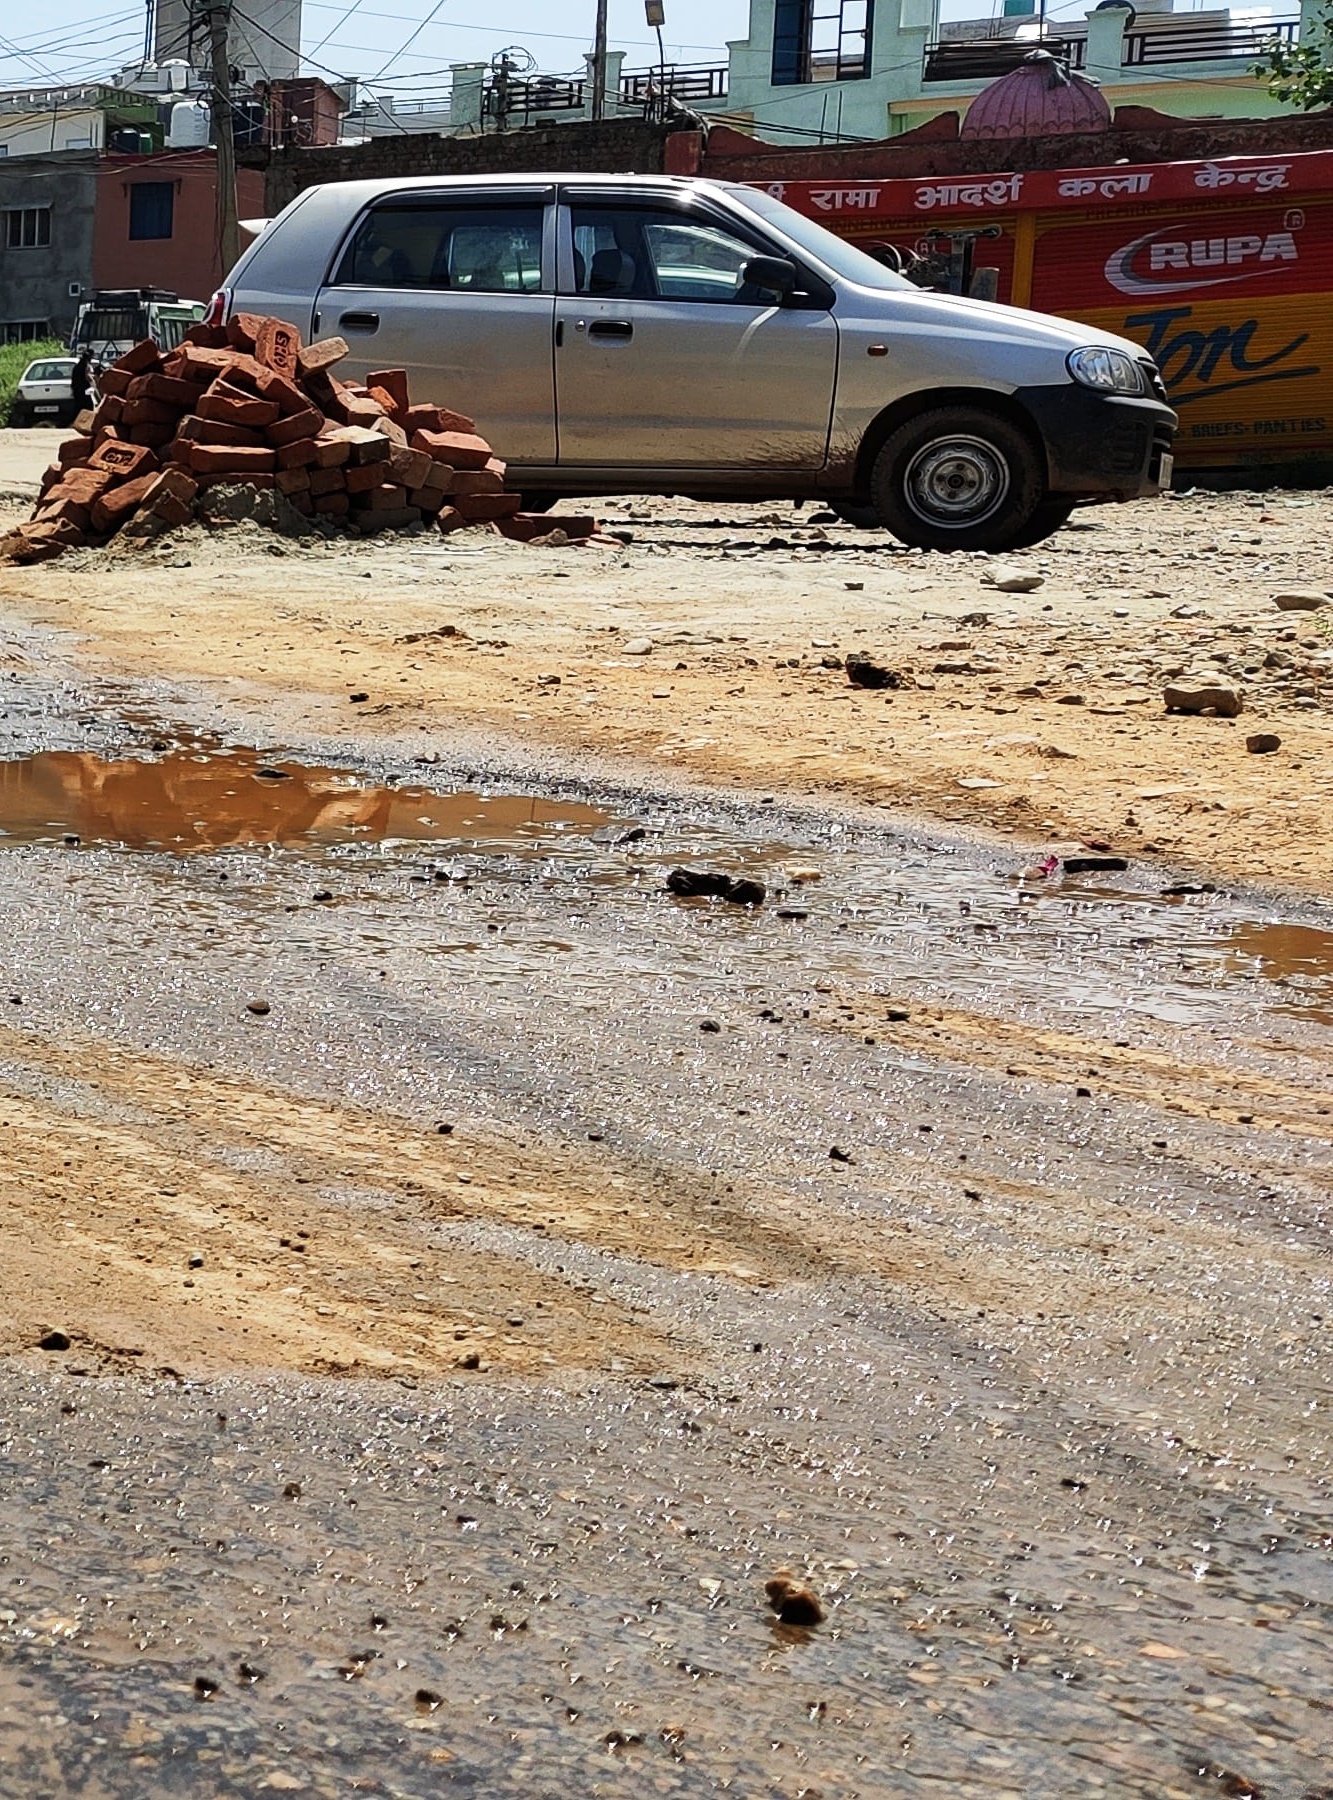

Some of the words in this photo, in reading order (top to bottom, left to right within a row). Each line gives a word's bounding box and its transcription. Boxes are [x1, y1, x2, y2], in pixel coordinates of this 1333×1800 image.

[809, 188, 881, 210] रामा
[914, 174, 1024, 209] आदर्श
[1058, 173, 1153, 198] कला
[1193, 163, 1293, 192] केन्द्र
[1149, 232, 1298, 270] RUPA
